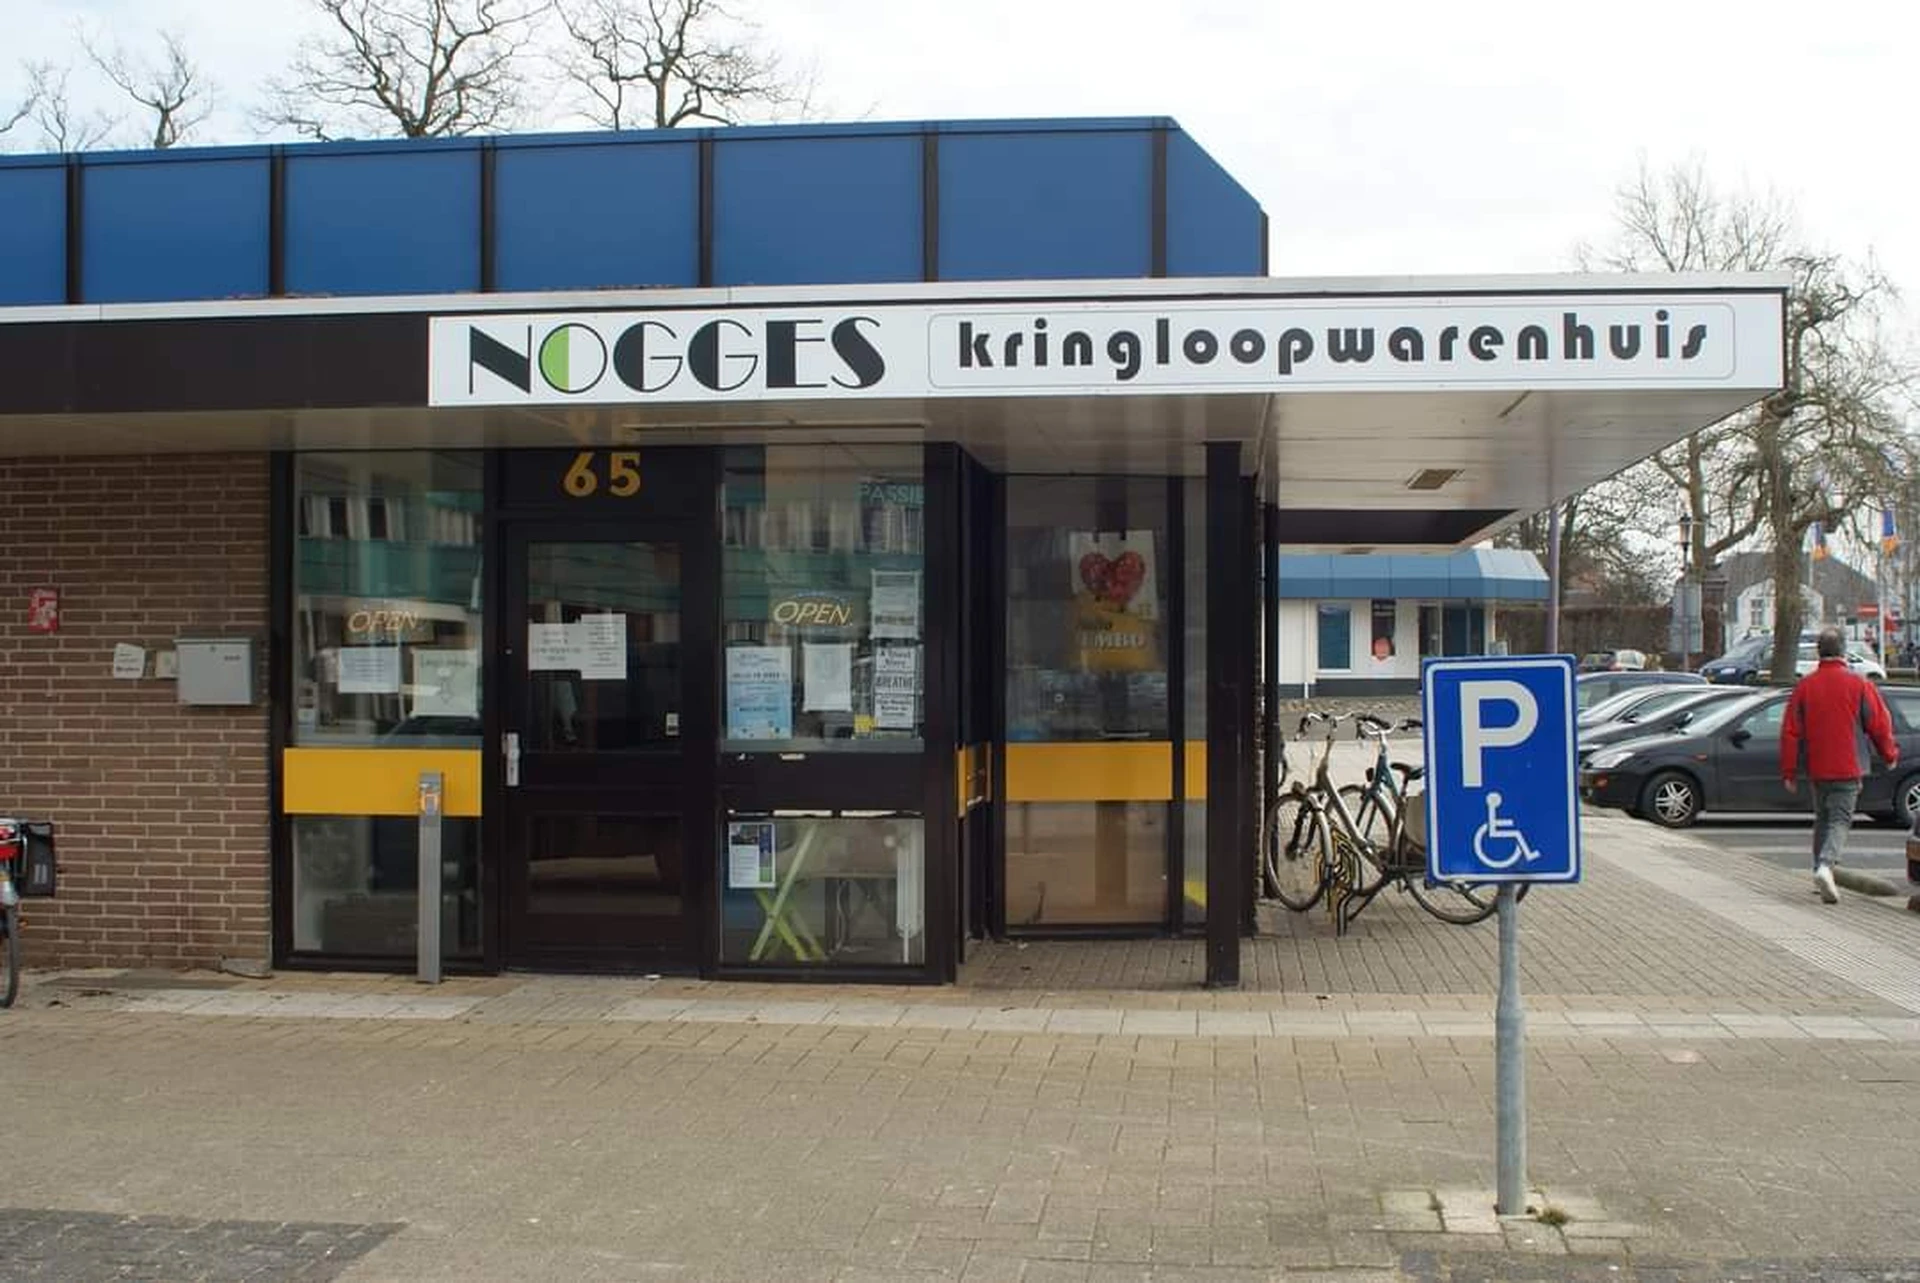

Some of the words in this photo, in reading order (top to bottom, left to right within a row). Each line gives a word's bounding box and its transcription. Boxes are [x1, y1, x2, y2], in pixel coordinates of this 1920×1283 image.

[468, 316, 886, 394] NOGGES
[957, 309, 1708, 380] kringloopwarenhuis
[773, 600, 851, 625] OPEN
[1460, 680, 1539, 787] P
